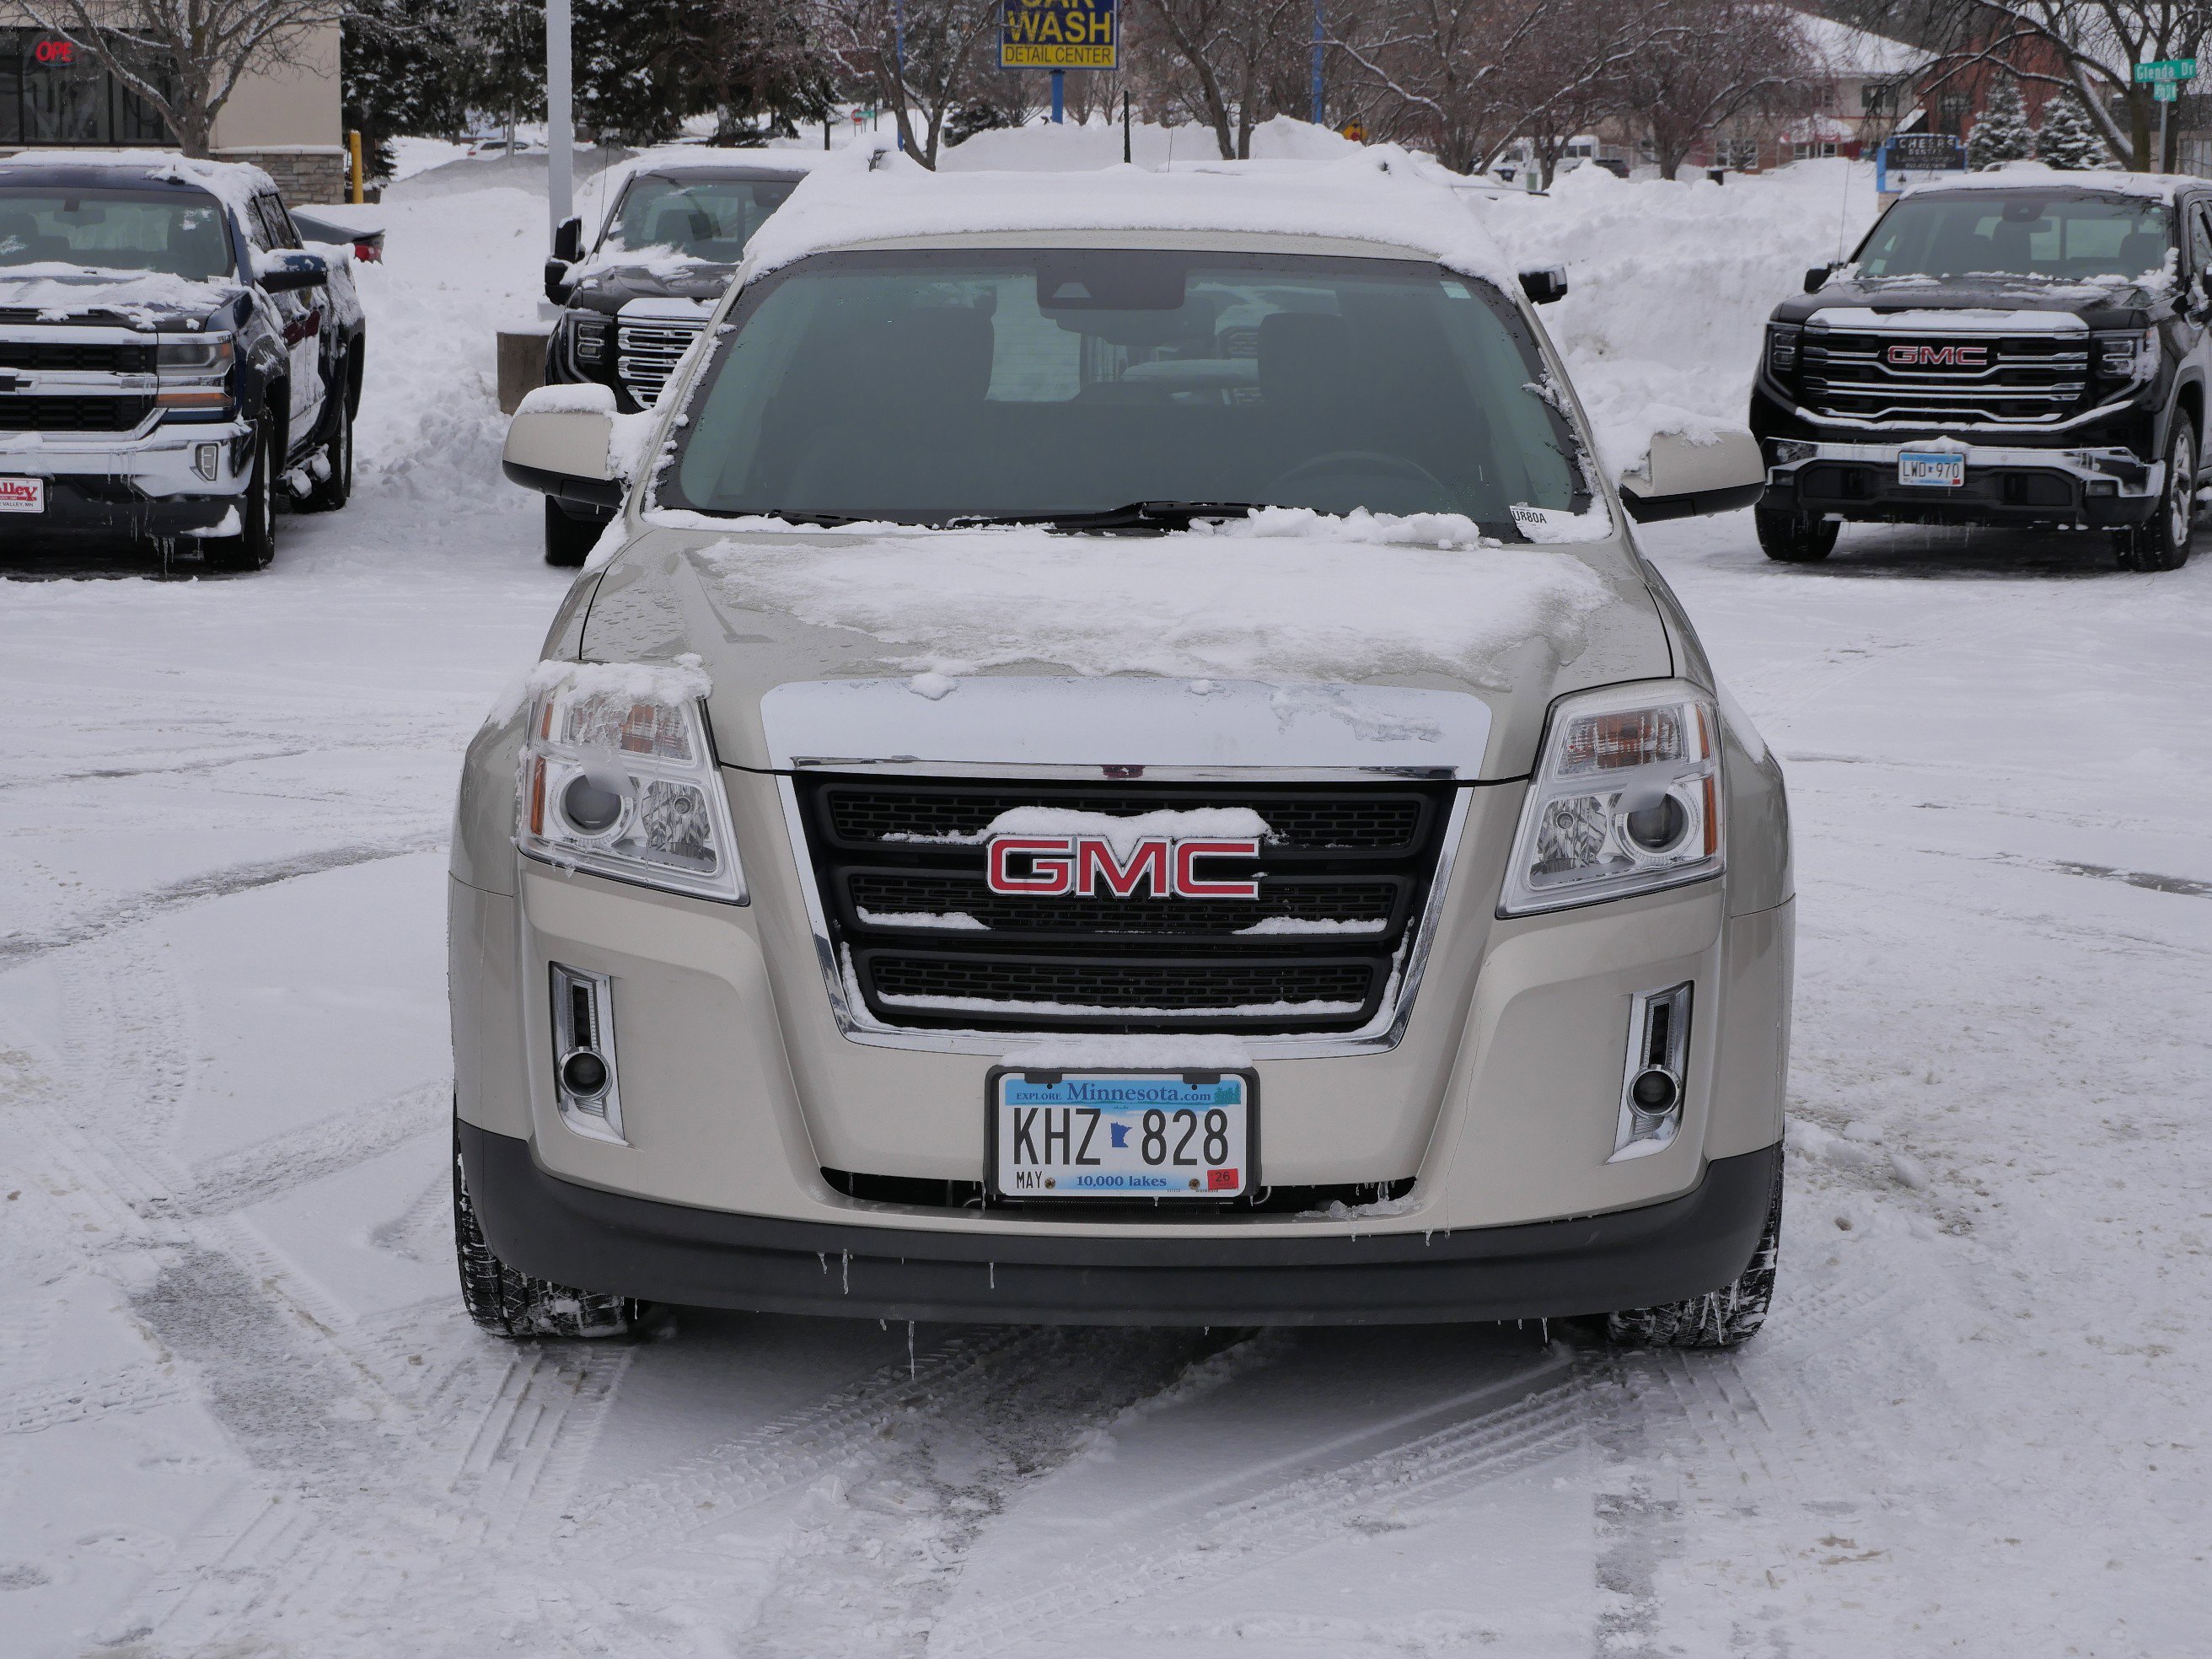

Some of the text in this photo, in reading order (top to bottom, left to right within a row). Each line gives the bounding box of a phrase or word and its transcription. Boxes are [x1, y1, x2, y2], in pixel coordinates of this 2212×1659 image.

[1007, 10, 1110, 43] WASH
[1005, 46, 1111, 63] DETAIL CENTER
[2136, 62, 2193, 80] Glenda Dr
[1887, 346, 1988, 365] GMC
[1936, 462, 1959, 479] 970
[987, 835, 1260, 899] GMC
[1017, 1093, 1062, 1101] EXPLORE
[1013, 1107, 1229, 1167] KHZ 828
[1017, 1171, 1168, 1189] MAY 10,000 lakes
[1215, 1171, 1231, 1183] 26
